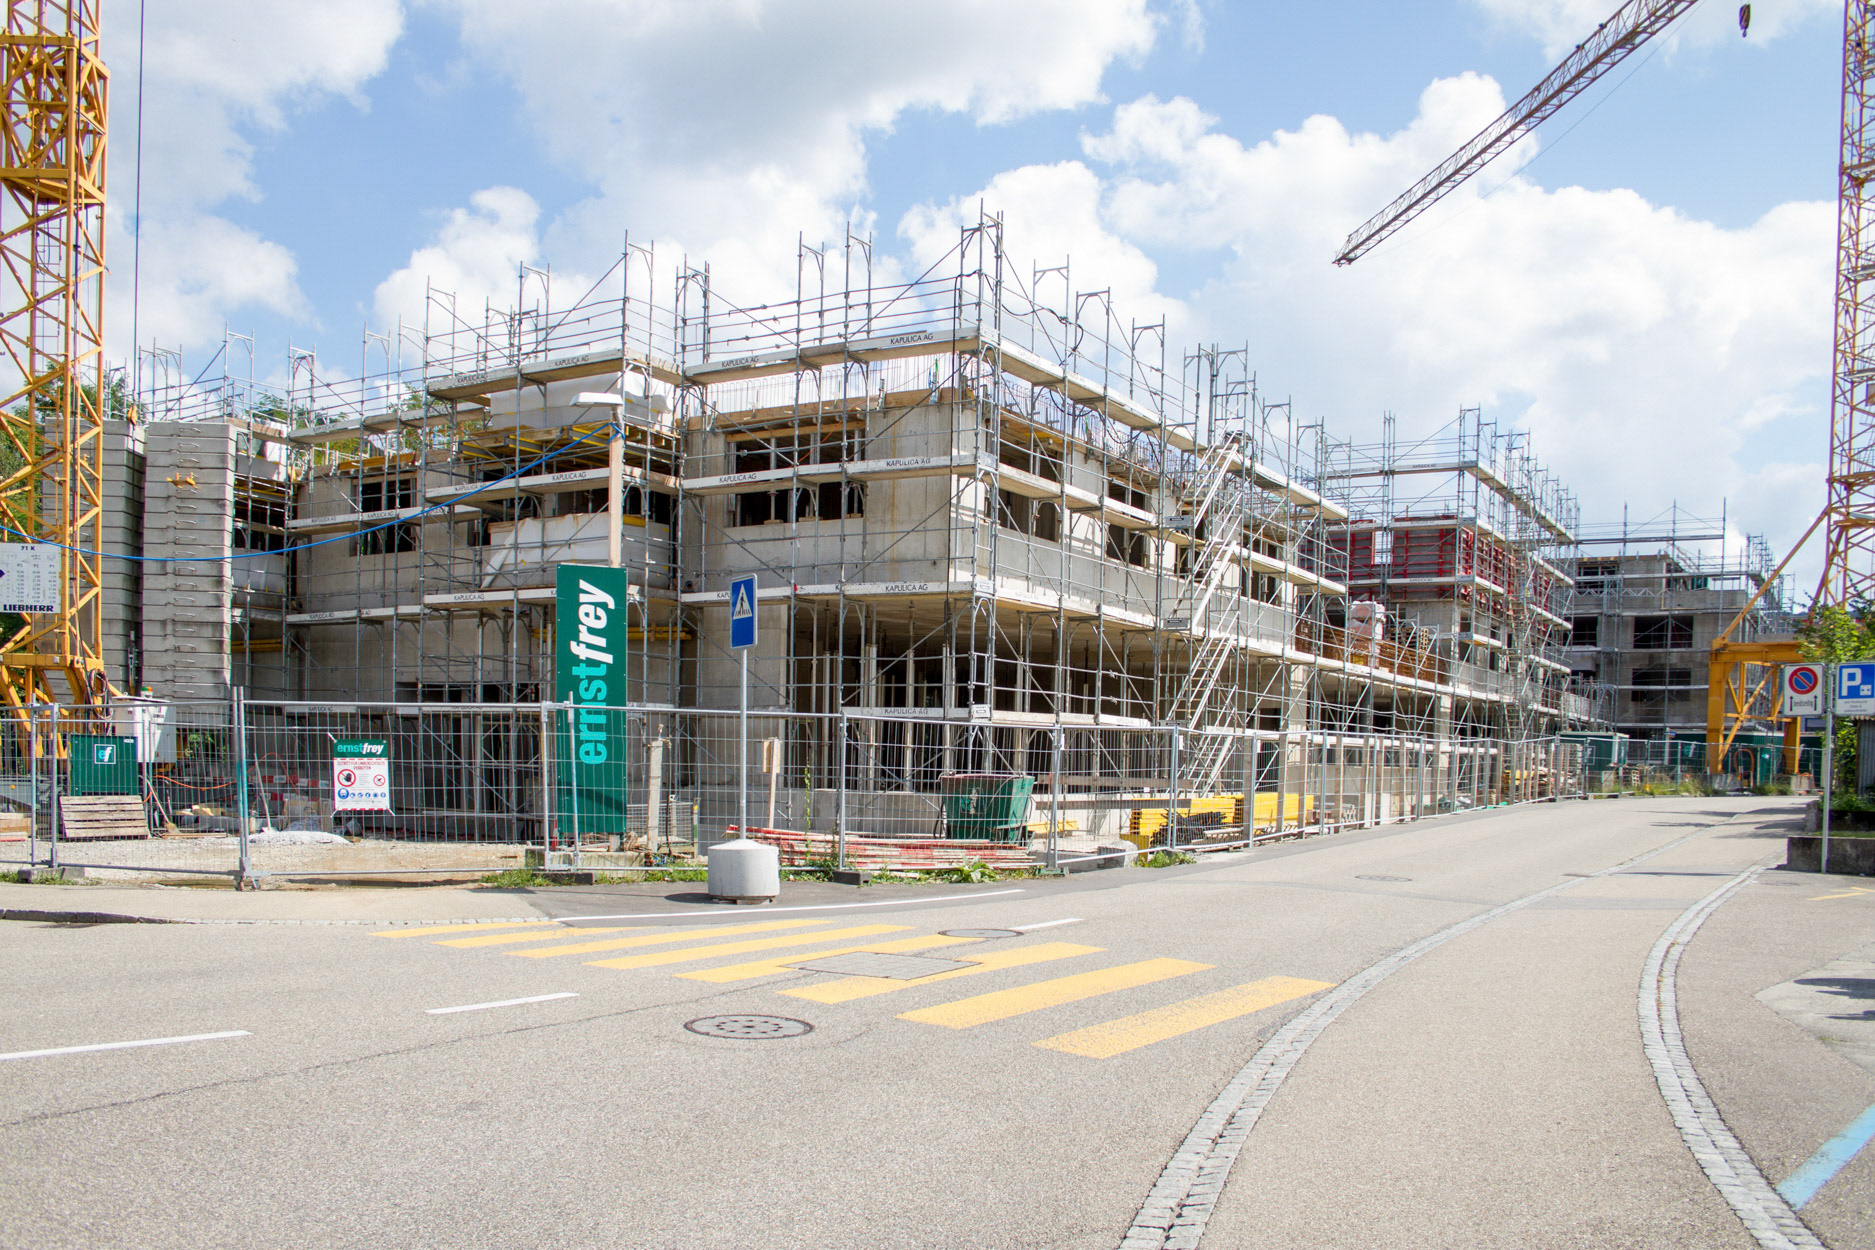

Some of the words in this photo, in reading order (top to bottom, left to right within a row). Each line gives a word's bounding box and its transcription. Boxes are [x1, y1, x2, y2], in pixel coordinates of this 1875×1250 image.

[891, 335, 922, 344] KAPULICA
[555, 358, 578, 366] KAPULICA
[722, 358, 748, 368] KAPULICA
[750, 356, 759, 364] AG
[886, 459, 919, 467] KAPULICA
[552, 472, 577, 481] KAPULICA
[719, 474, 746, 483] KAPULICA
[570, 578, 615, 765] ernstfrey
[1842, 668, 1862, 696] P
[337, 743, 384, 754] ernstfrey
[98, 746, 112, 762] ef
